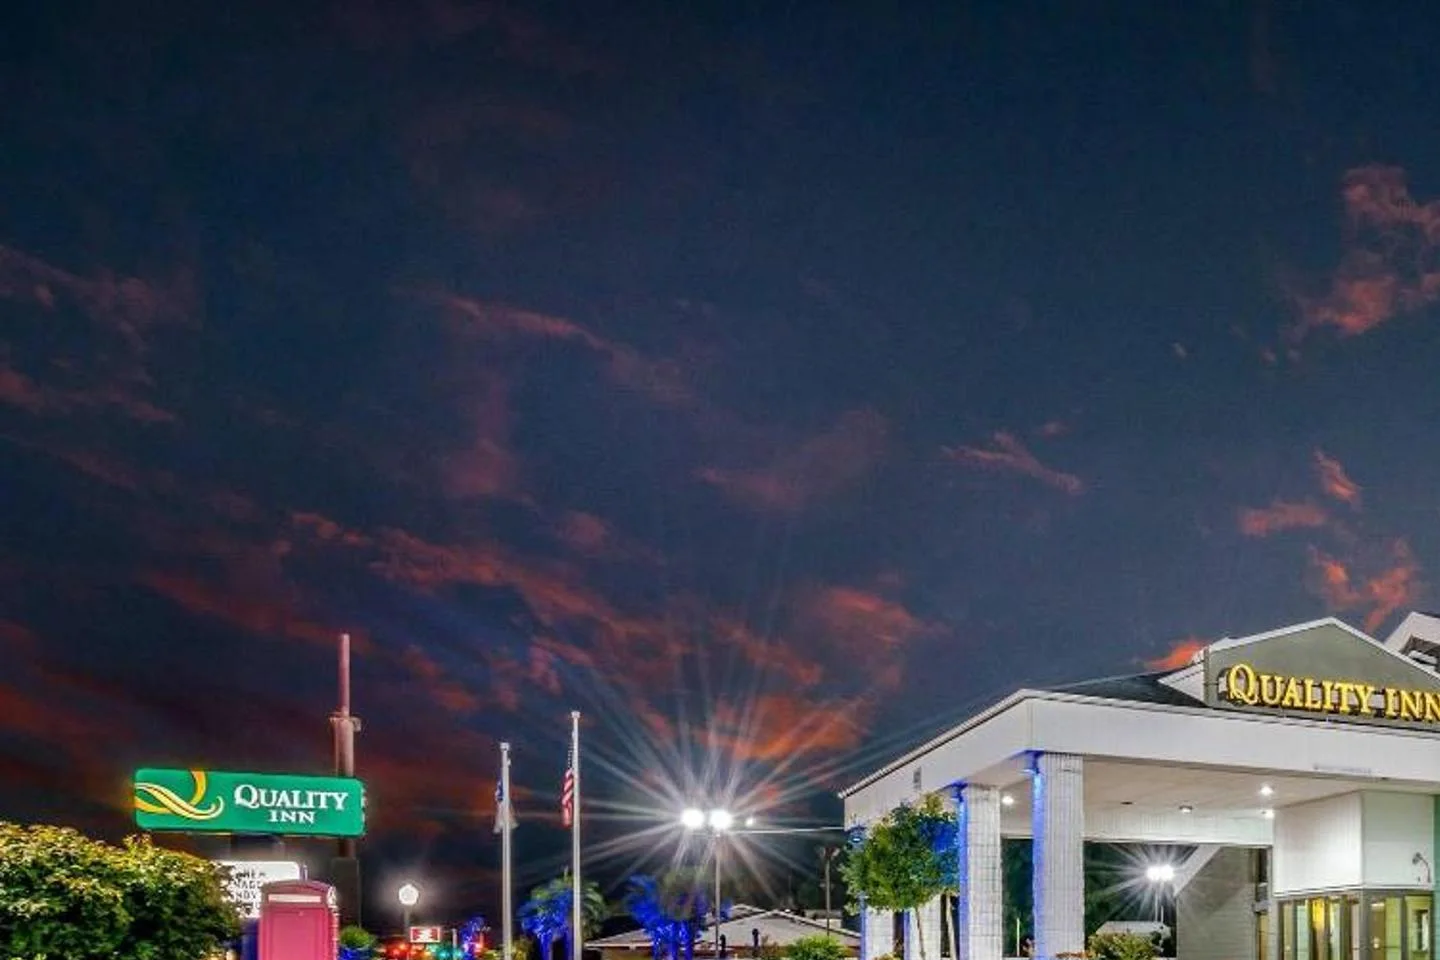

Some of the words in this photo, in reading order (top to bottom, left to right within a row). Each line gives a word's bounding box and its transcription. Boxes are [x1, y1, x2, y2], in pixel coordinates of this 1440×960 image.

[1228, 664, 1375, 713] QUALITY
[233, 784, 348, 810] QUALITY
[268, 810, 315, 824] INN
